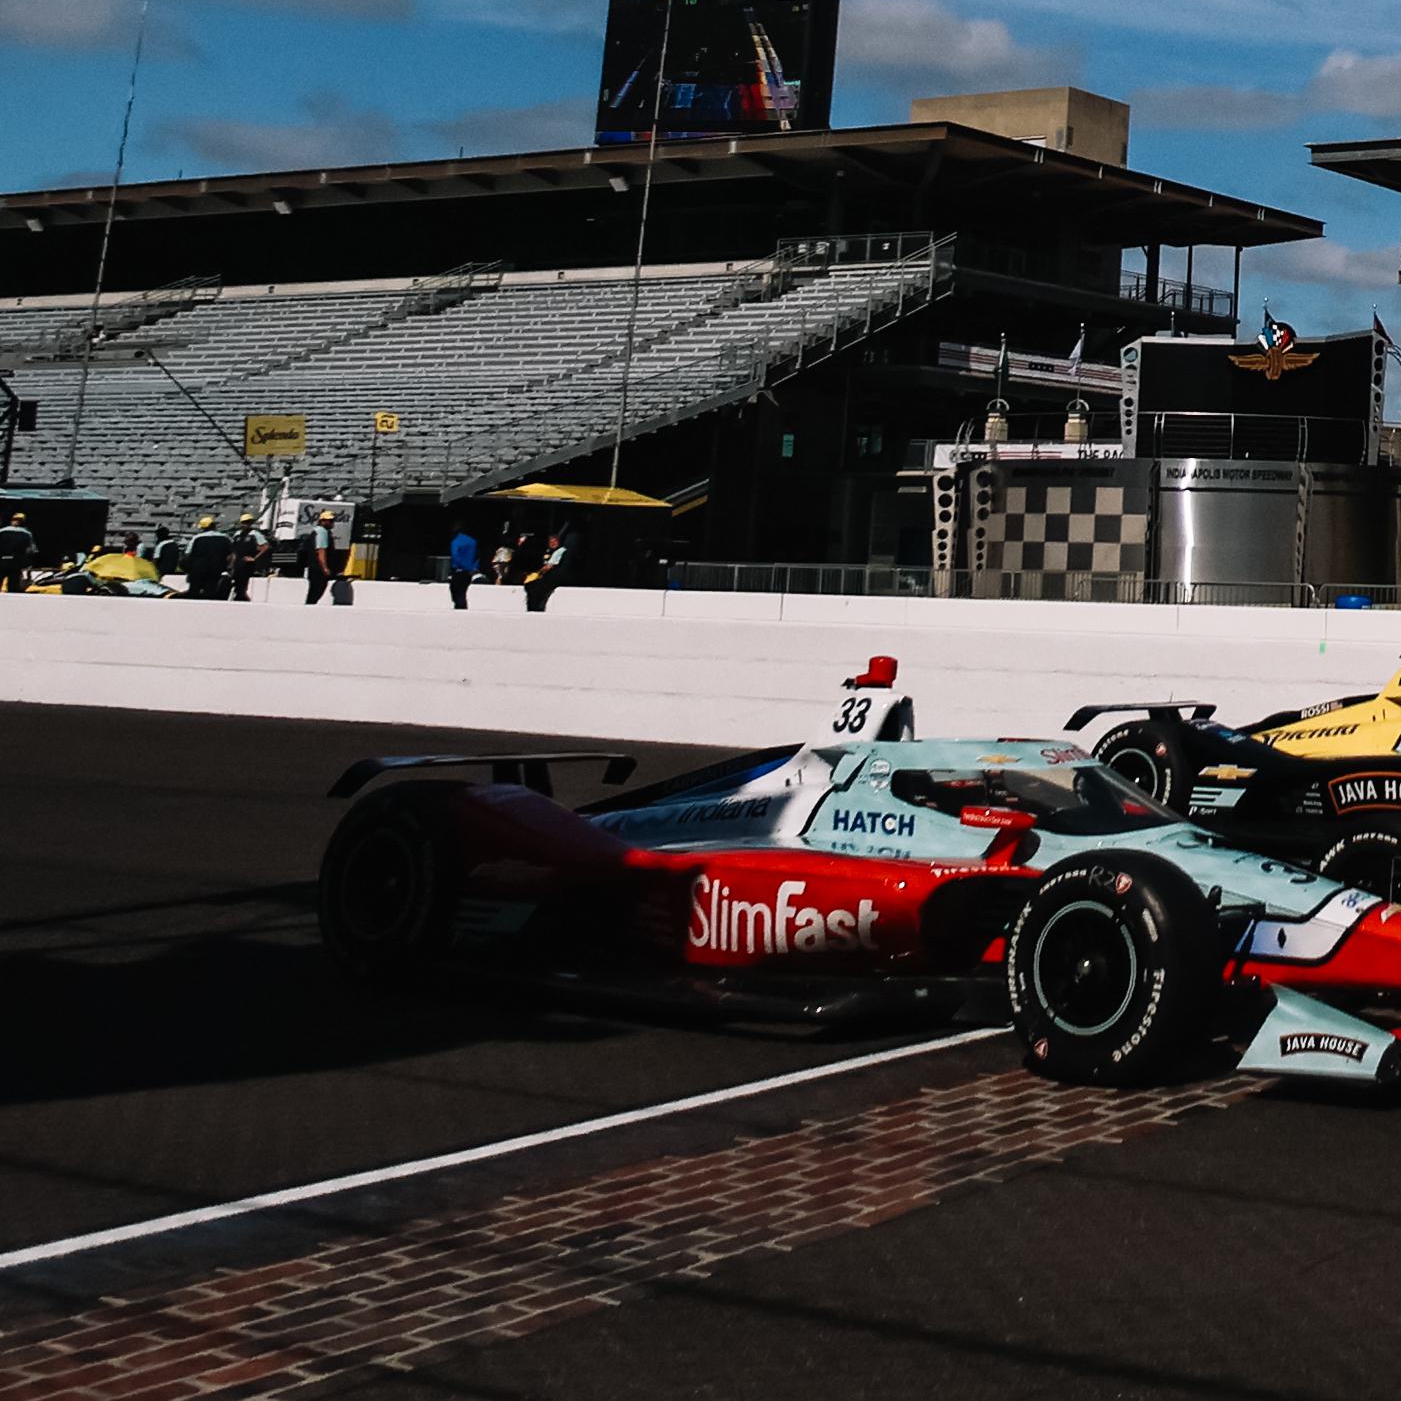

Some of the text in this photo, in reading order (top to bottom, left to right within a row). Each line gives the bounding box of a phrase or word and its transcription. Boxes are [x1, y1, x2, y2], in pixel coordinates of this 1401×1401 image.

[1166, 467, 1220, 480] INDIAAPOLIS
[832, 696, 872, 733] 33
[1301, 703, 1330, 720] ROSSI
[1338, 780, 1378, 805] JAVA
[833, 809, 916, 837] HATCH
[688, 873, 880, 954] SlimFast
[1112, 967, 1166, 1063] Firestone
[1286, 1036, 1363, 1056] JAVA HOUSE
